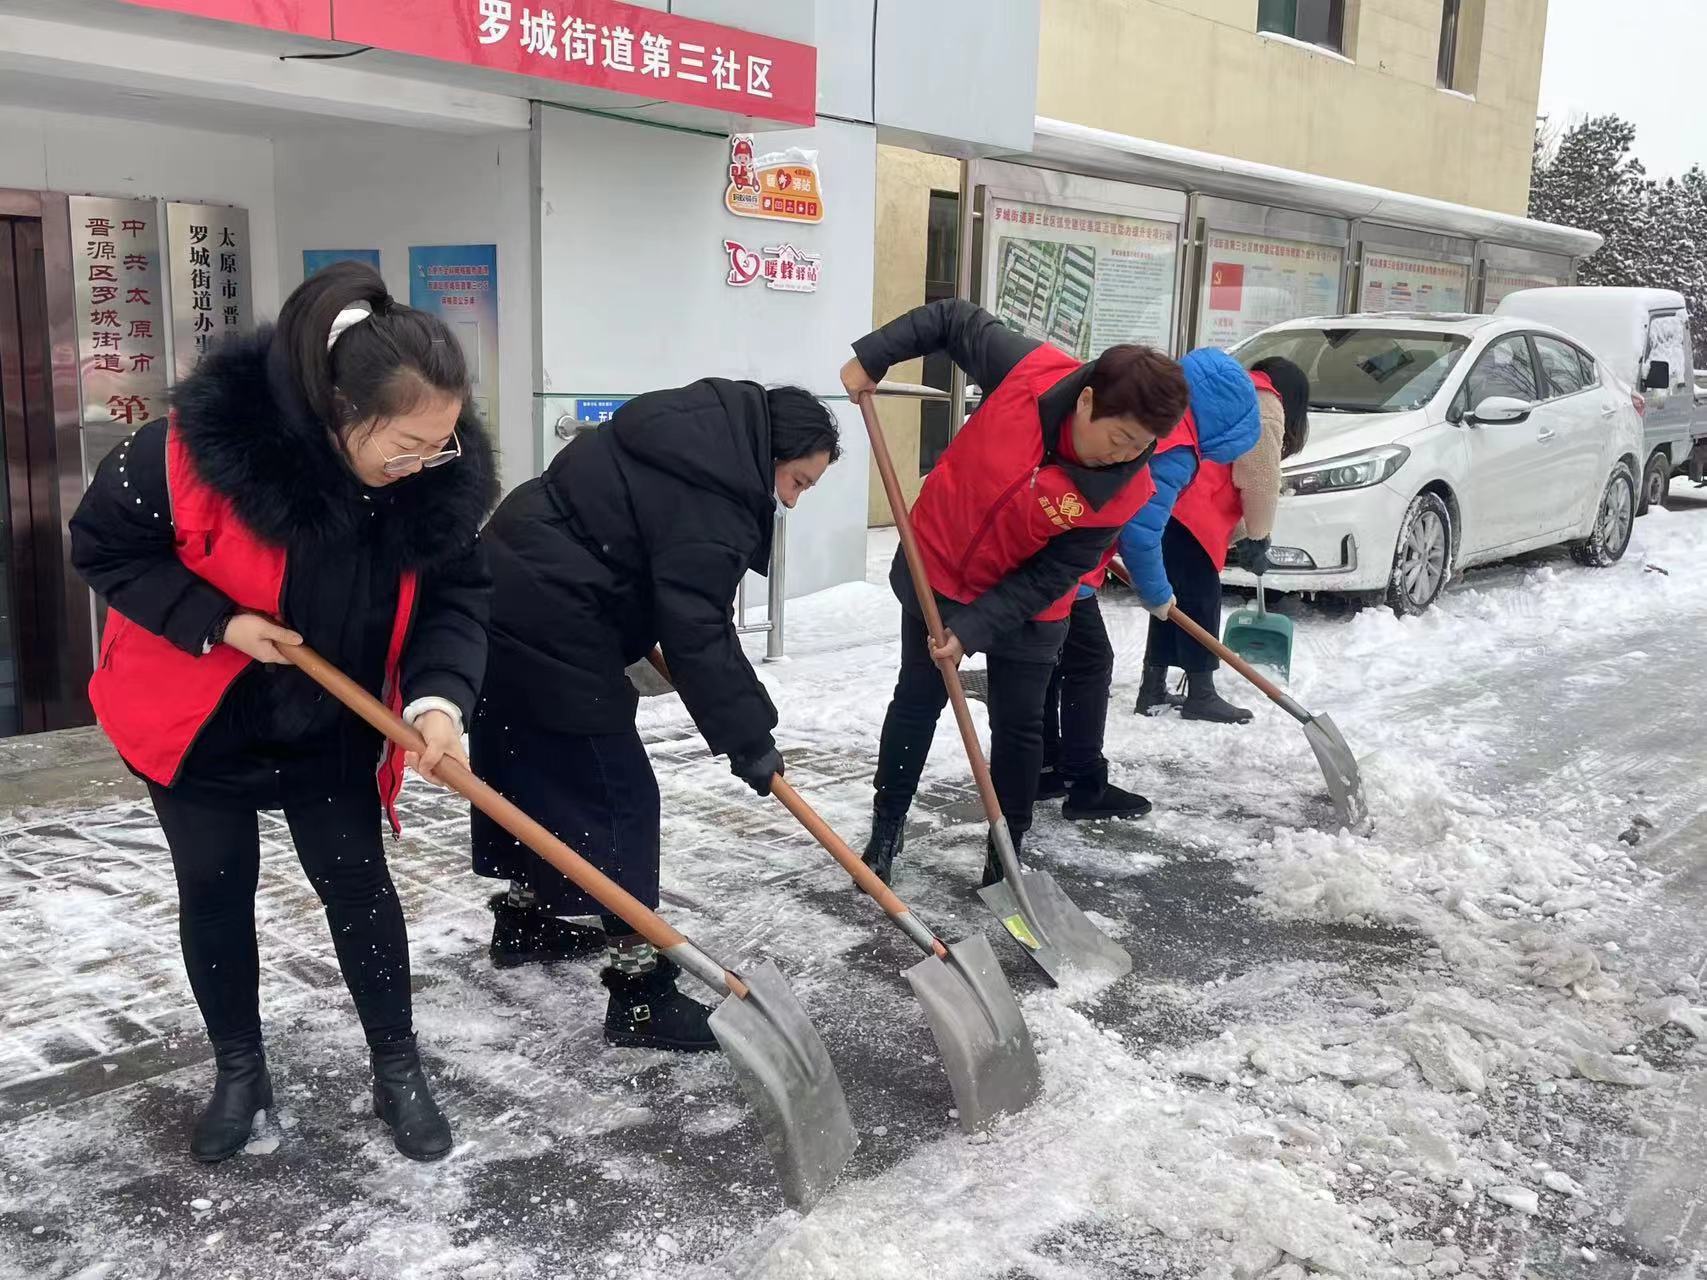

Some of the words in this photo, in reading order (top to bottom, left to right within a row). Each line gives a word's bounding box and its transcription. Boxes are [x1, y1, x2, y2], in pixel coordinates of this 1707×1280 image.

[478, 0, 773, 98] 罗城街道第三社区
[85, 218, 125, 373] 晋源区罗城街道
[122, 220, 155, 372] 中共太原市
[218, 227, 240, 336] 太原市晋
[106, 395, 150, 424] 第
